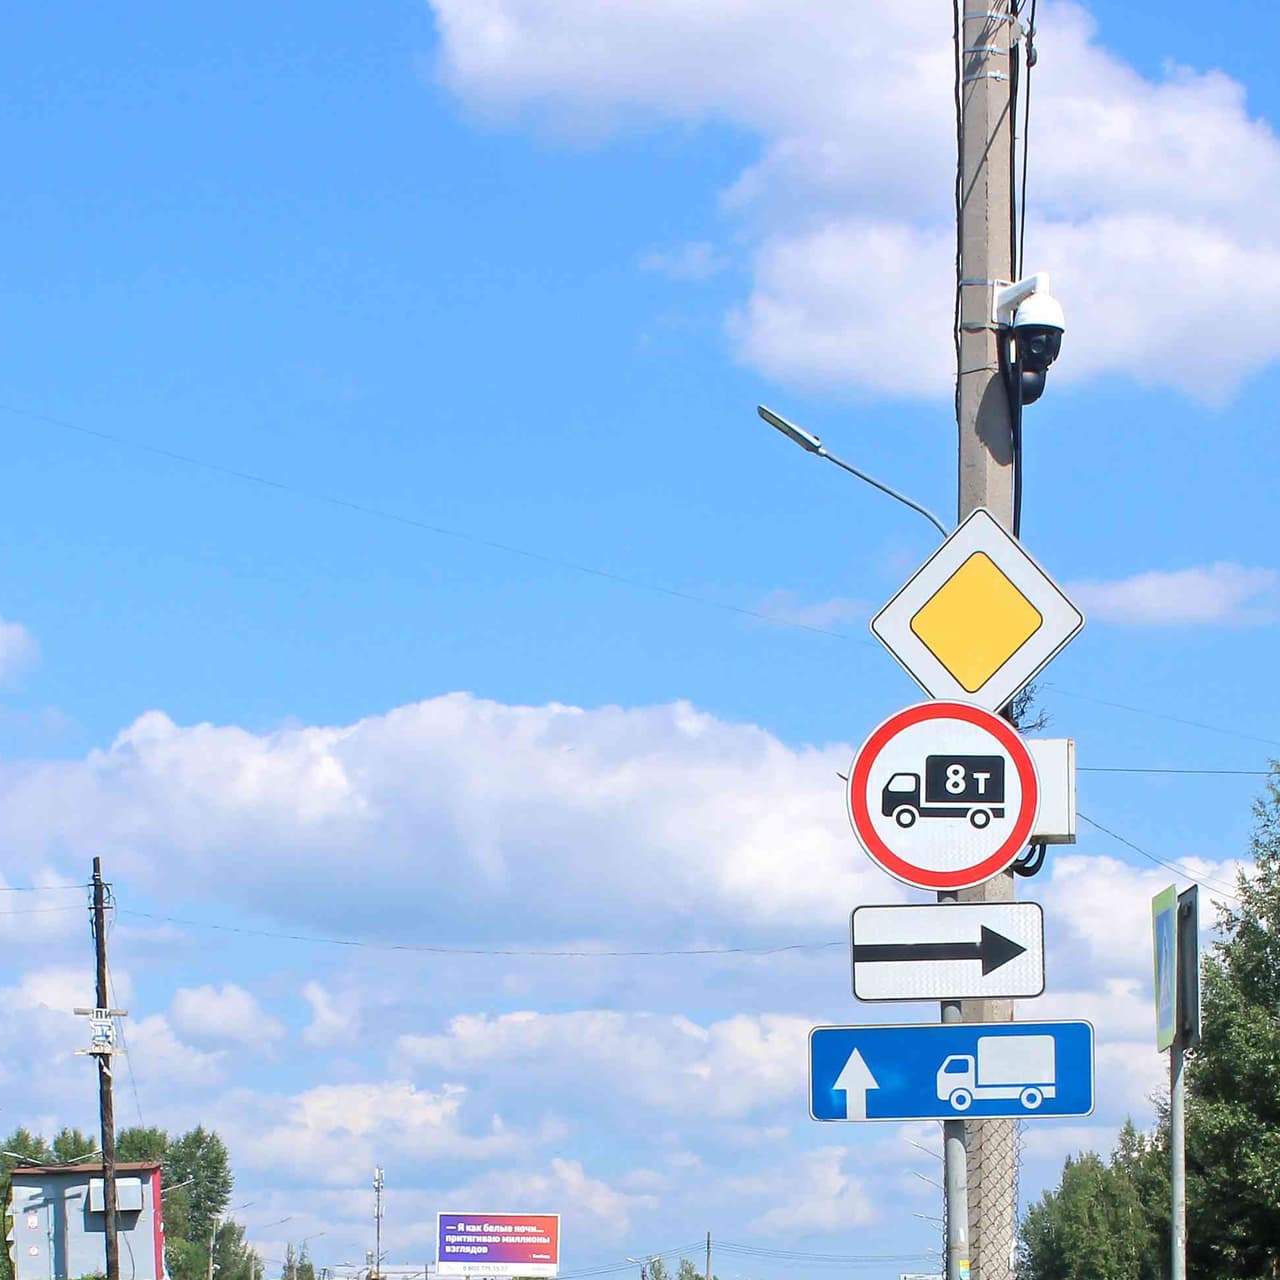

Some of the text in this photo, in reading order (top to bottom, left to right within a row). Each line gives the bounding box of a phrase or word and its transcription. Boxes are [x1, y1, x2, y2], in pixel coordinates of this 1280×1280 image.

[483, 1223, 513, 1232] белые
[501, 1236, 550, 1244] миллионы
[445, 1245, 488, 1254] взглядов
